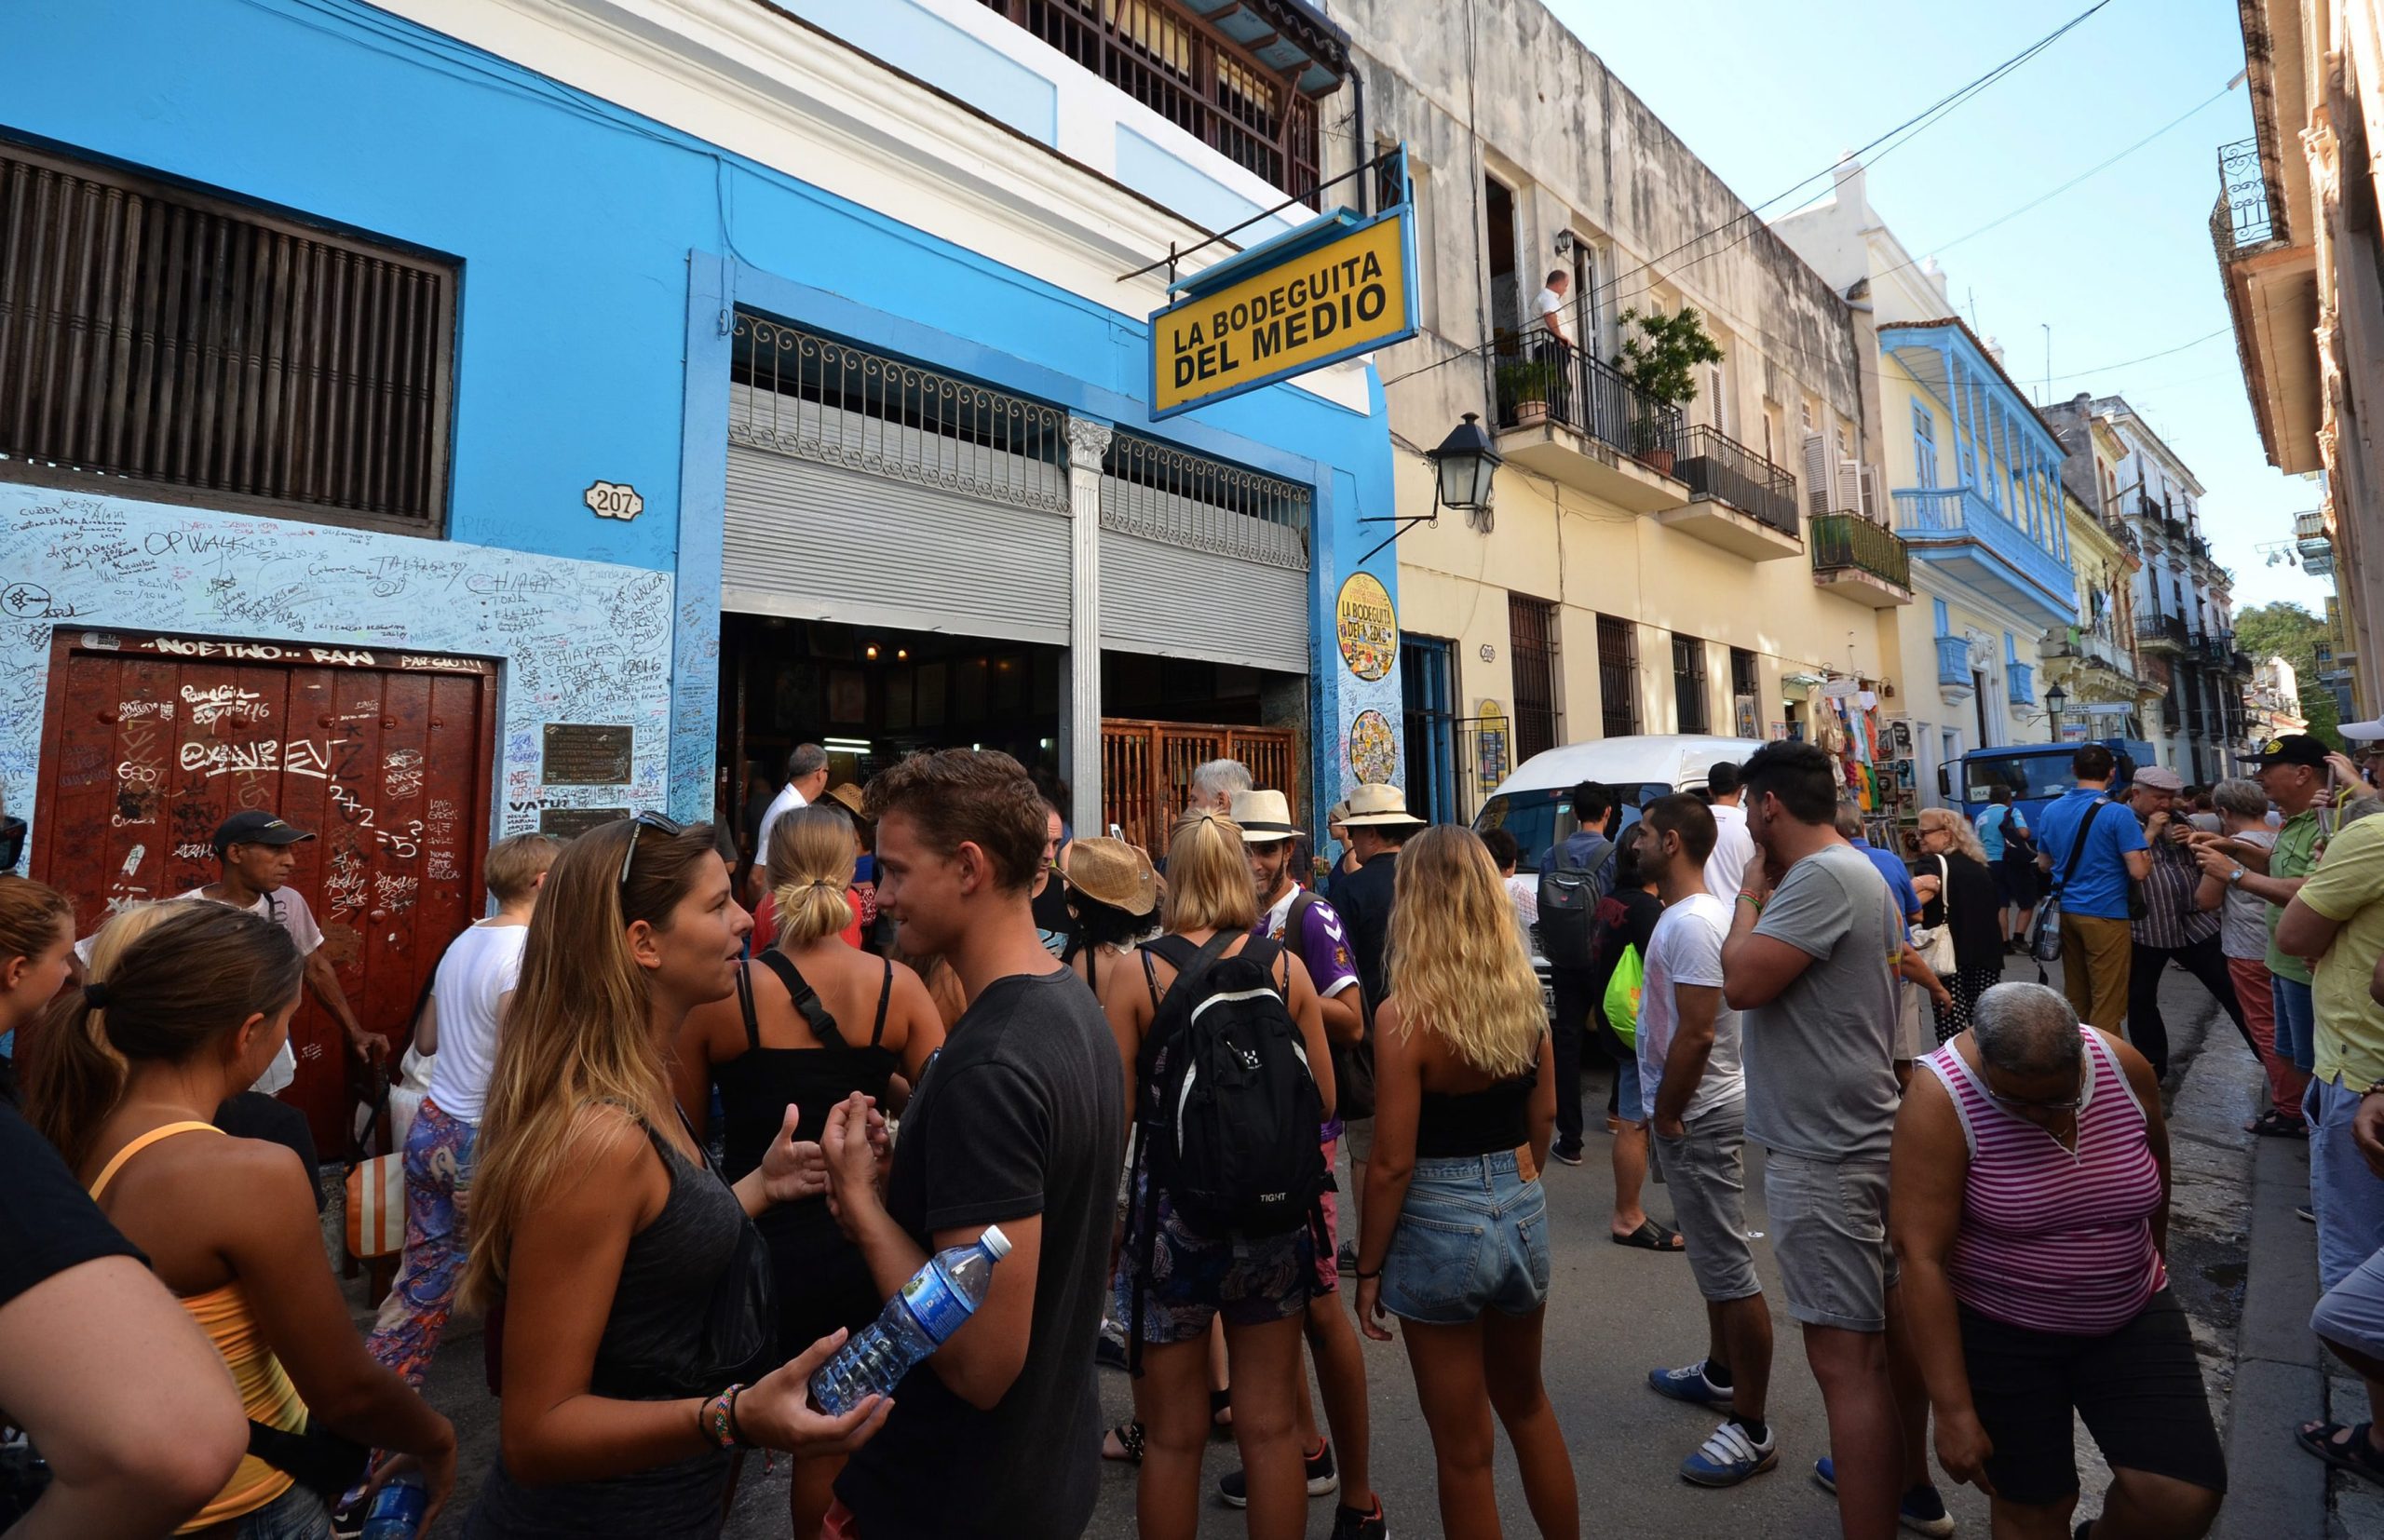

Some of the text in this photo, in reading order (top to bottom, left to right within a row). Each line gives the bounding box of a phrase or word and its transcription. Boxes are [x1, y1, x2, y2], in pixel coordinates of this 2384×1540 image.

[1173, 250, 1383, 356] LA BODEGUITA
[1174, 283, 1387, 389] DEL MEDIO
[597, 490, 633, 514] 207
[1342, 601, 1350, 616] LA
[1352, 602, 1391, 626] BODEGUITA
[1260, 1192, 1286, 1202] TIGHT
